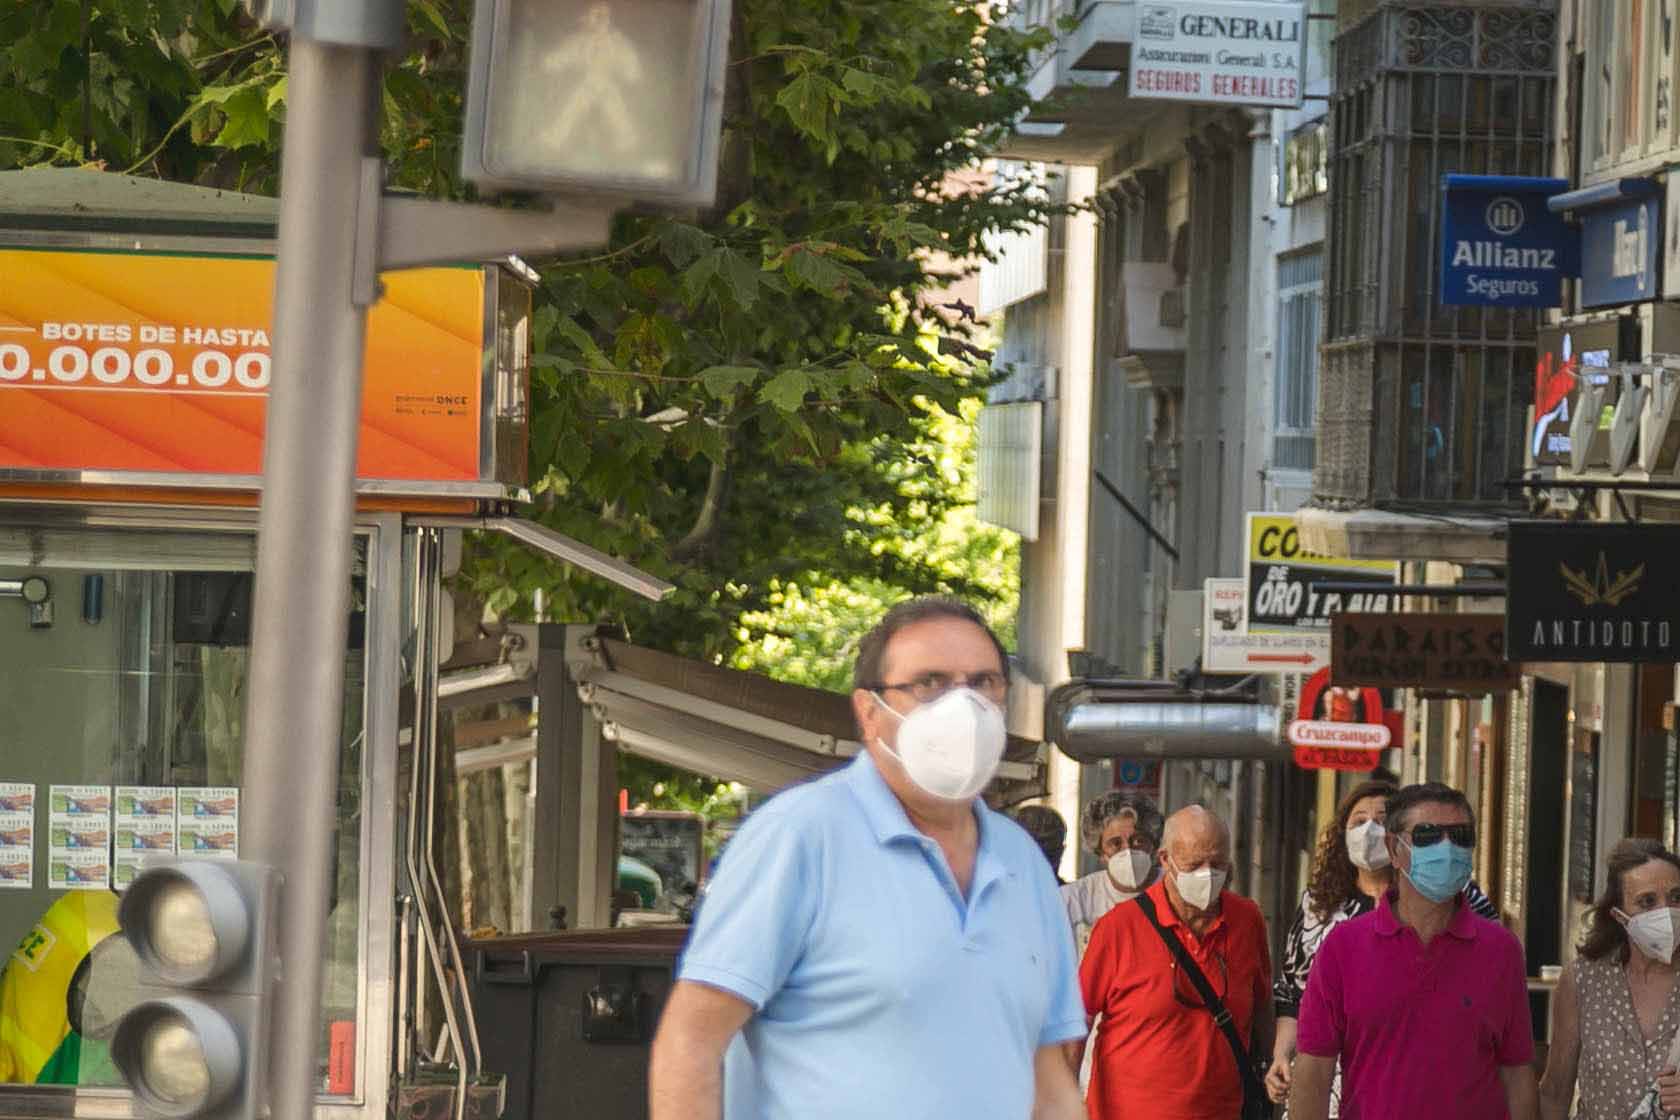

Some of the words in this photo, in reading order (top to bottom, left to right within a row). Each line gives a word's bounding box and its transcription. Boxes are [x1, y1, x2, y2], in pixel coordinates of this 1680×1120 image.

[1180, 14, 1299, 41] GENERALI
[1136, 69, 1201, 93] SEGUROS
[1213, 74, 1297, 99] GENERALES
[1451, 240, 1556, 270] Allianz
[1466, 274, 1539, 297] Seguros
[42, 322, 131, 342] BOTES
[140, 324, 176, 343] DE
[184, 327, 270, 347] HASTA
[1255, 581, 1303, 617] ORO
[1533, 620, 1670, 647] ANTIDOTO
[1297, 727, 1382, 745] Cruzcampo
